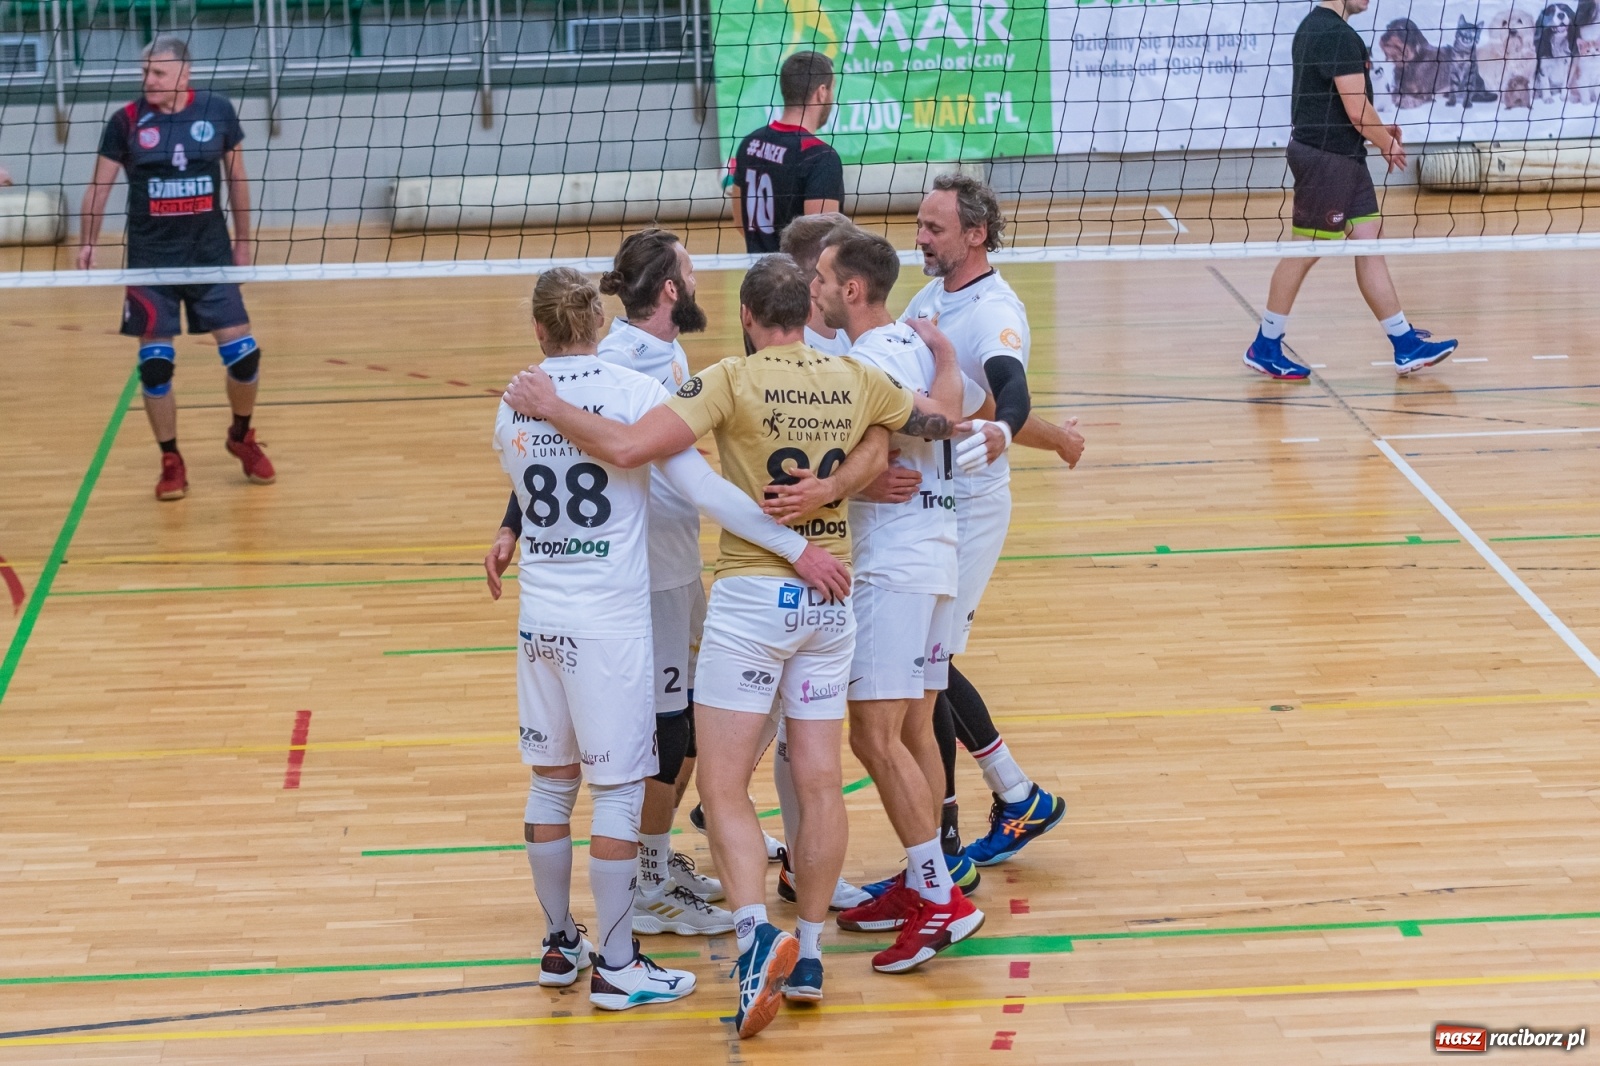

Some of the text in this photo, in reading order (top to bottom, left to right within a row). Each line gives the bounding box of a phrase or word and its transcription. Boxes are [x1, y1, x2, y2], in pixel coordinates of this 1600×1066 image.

[841, 0, 1014, 54] MAR
[1140, 31, 1161, 53] się
[1217, 30, 1257, 52] pasją
[843, 50, 1015, 77] sklep zoologiczny
[1138, 59, 1156, 76] od
[1163, 57, 1201, 76] 1989
[1207, 56, 1248, 74] roku.
[172, 143, 188, 171] 4
[746, 168, 775, 234] 10
[765, 389, 852, 405] MICHALAK
[788, 417, 852, 430] ZOO-MAR
[533, 447, 591, 458] LUNATY
[523, 462, 611, 528] 88
[526, 536, 610, 558] TropiDog
[784, 605, 847, 633] glass
[524, 638, 578, 667] glass
[663, 667, 681, 693] 2
[739, 681, 773, 693] wepol
[522, 740, 548, 751] epol
[921, 859, 940, 889] FILA
